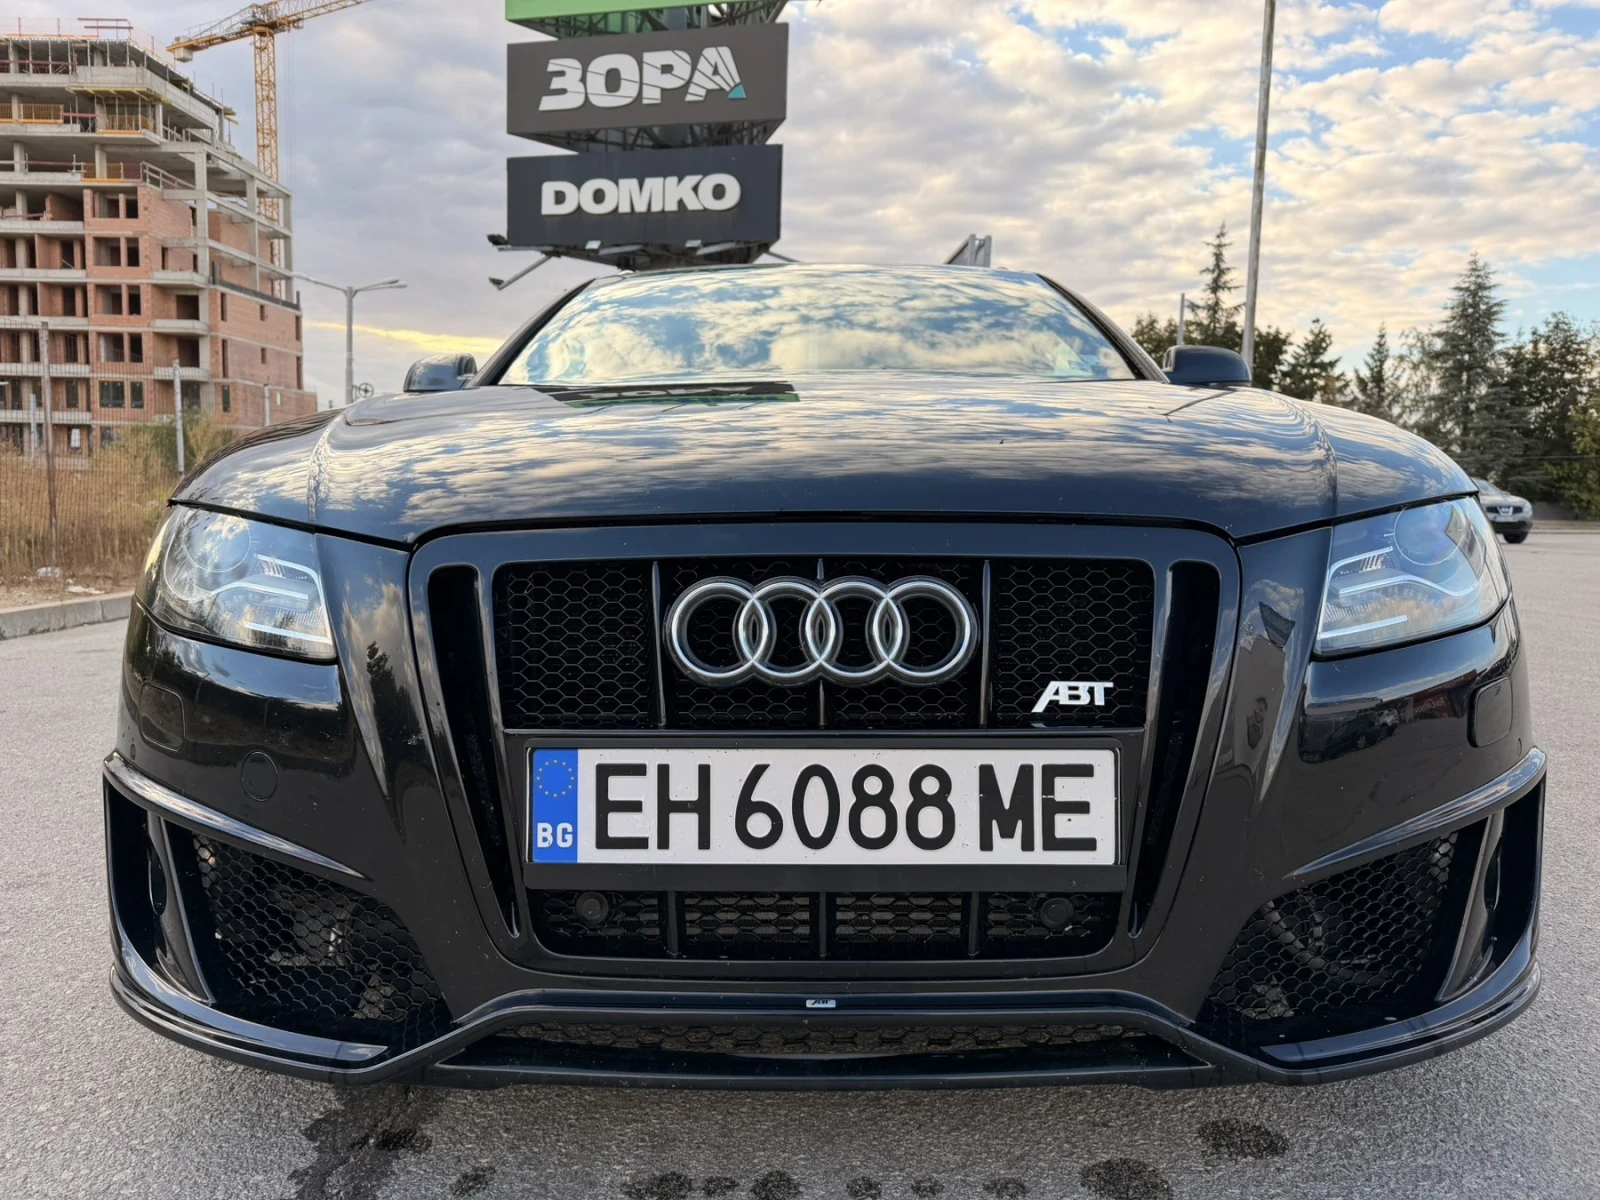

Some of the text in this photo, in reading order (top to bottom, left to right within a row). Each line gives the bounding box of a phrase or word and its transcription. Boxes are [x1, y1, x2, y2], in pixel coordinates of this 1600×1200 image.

[538, 46, 747, 111] ЗОРА
[541, 173, 741, 215] DOMKO
[1031, 681, 1114, 713] ABT
[595, 763, 1097, 851] EH 6088 ME
[536, 822, 573, 848] BG
